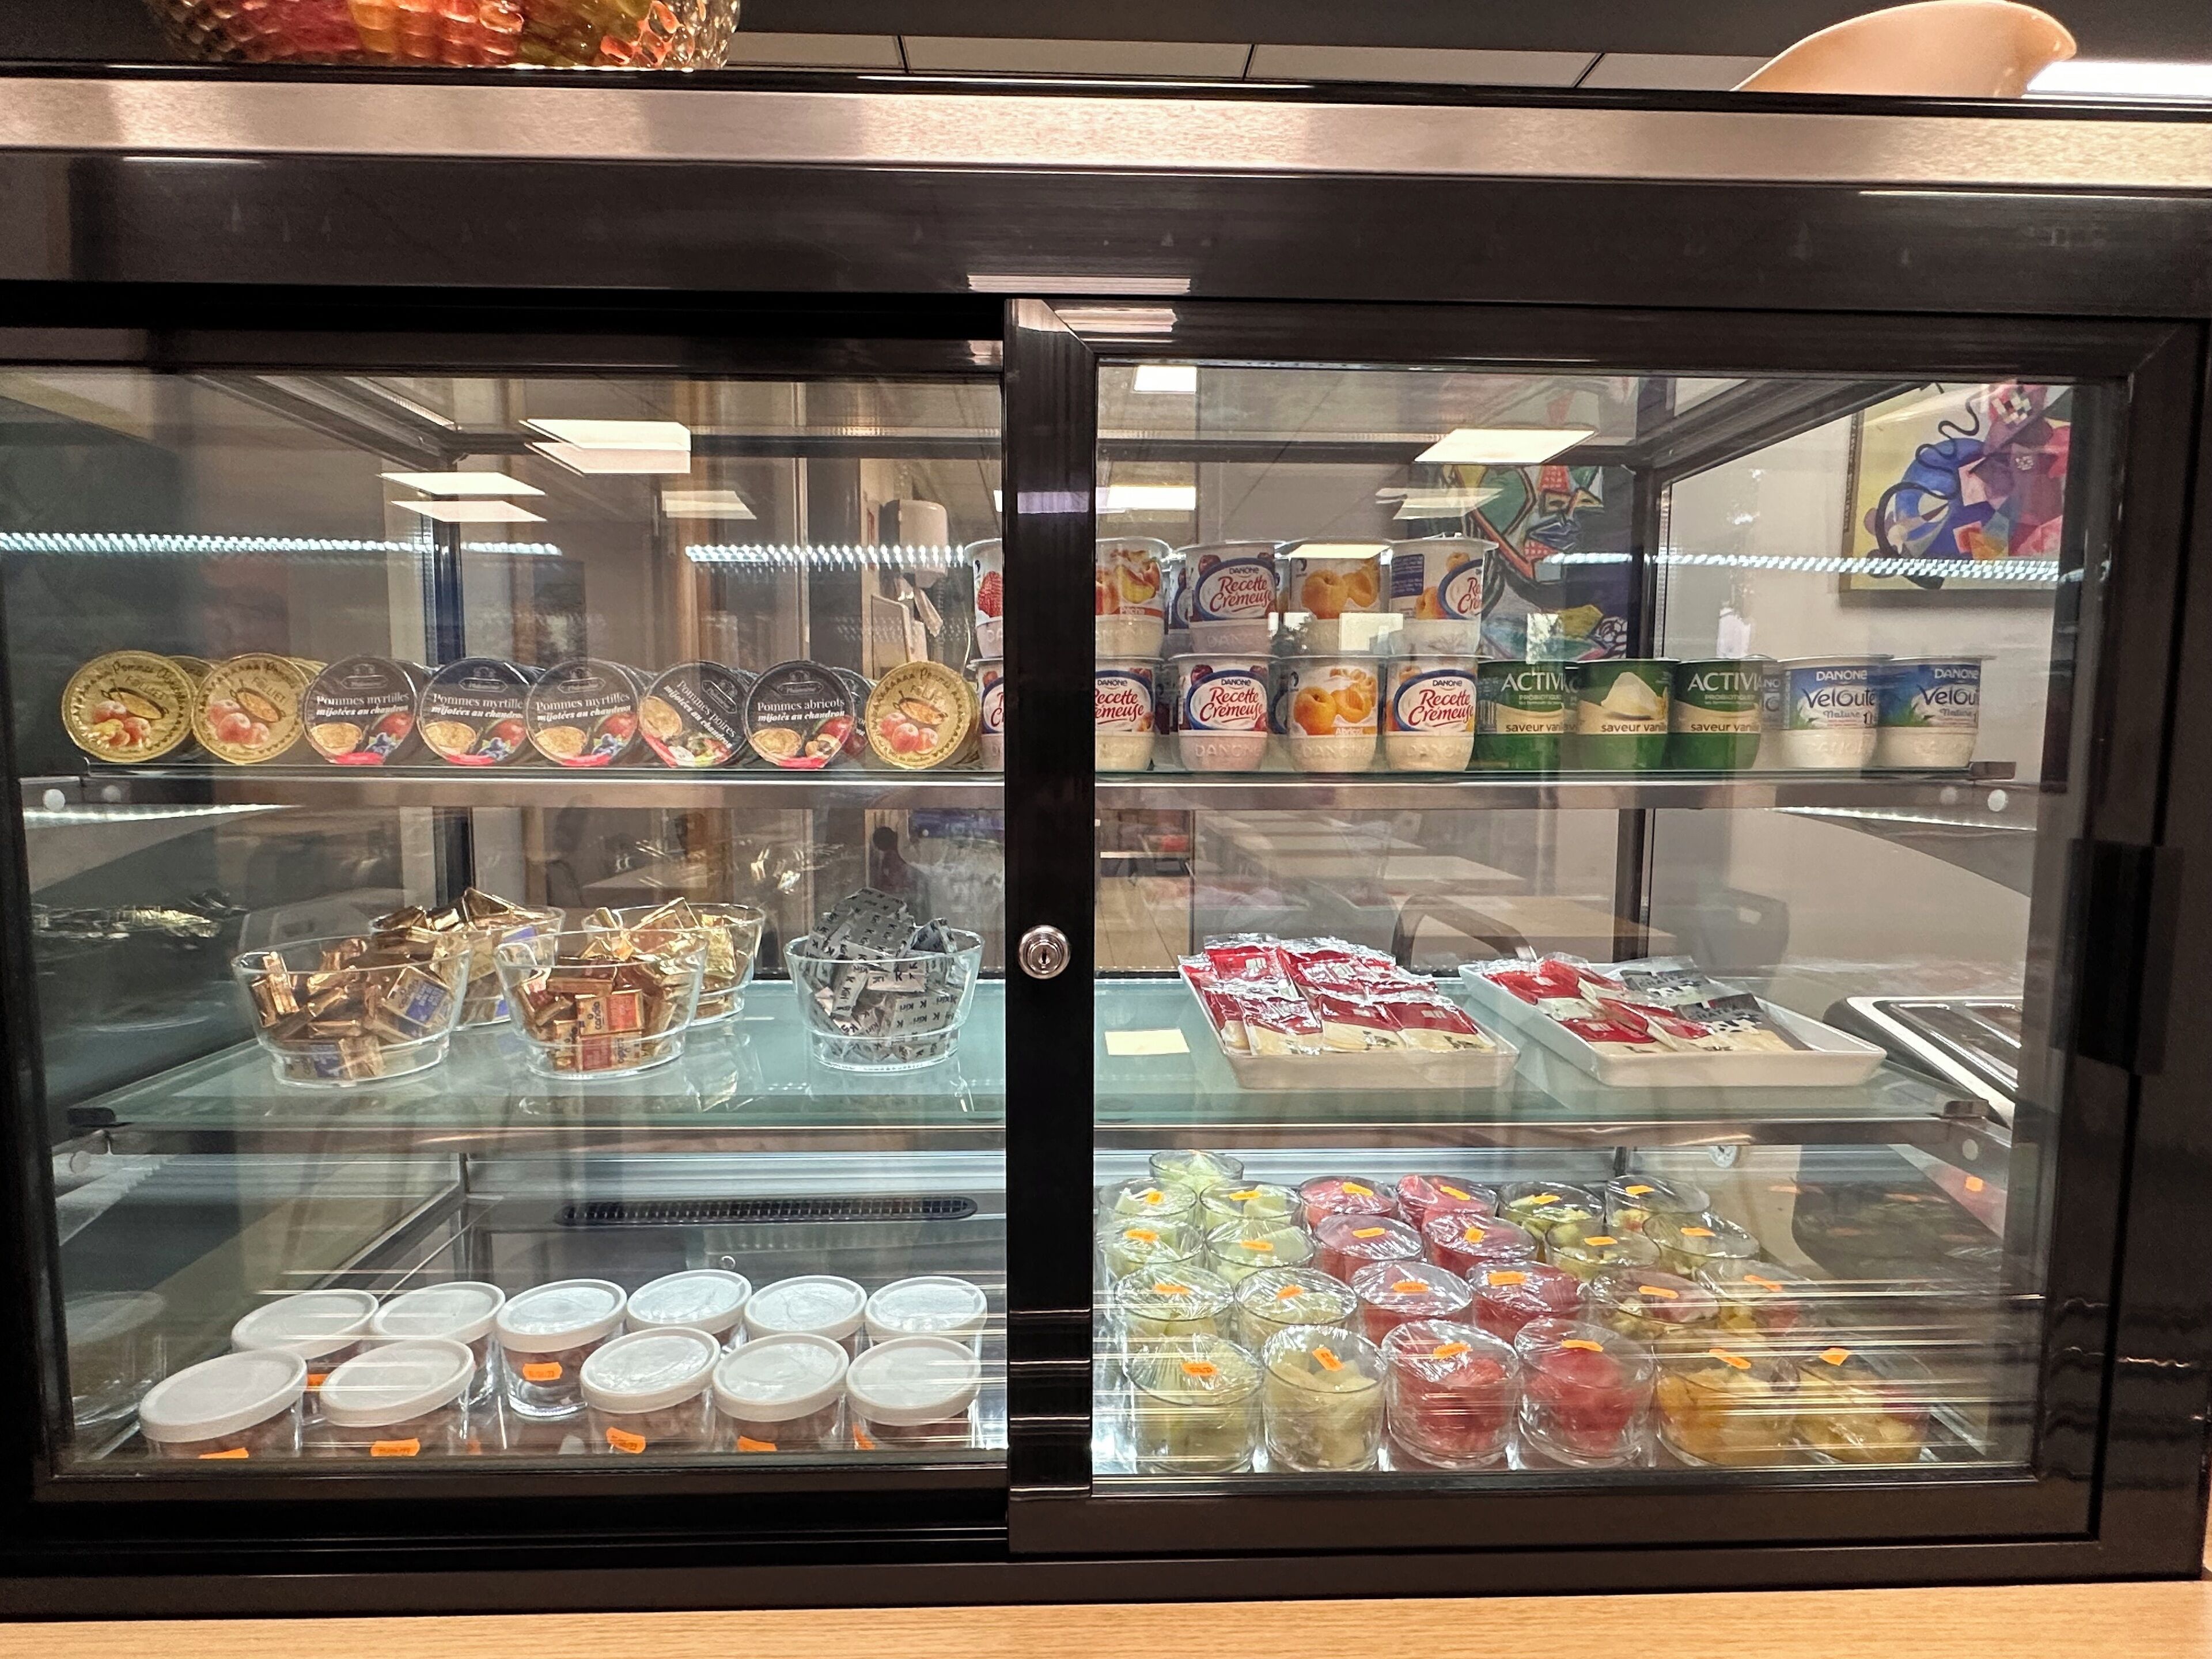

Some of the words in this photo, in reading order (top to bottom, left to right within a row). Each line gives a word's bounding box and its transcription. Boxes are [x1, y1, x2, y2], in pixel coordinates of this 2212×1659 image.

[1218, 575, 1267, 594] Recette
[317, 695, 365, 706] Pommes
[367, 692, 410, 704] myrtilles
[433, 694, 480, 706] Pommes
[536, 699, 583, 711] Pommes
[585, 692, 630, 708] myrtilles
[1209, 686, 1259, 704] Recette
[1419, 689, 1470, 707] Recette
[677, 680, 712, 715] Pommes
[709, 713, 736, 737] poires
[757, 702, 802, 711] Pommes
[804, 698, 845, 709] abricots
[804, 710, 845, 719] chaudron
[1506, 723, 1543, 732] saveur
[1601, 724, 1641, 732] saveur
[1691, 723, 1730, 732] saveur
